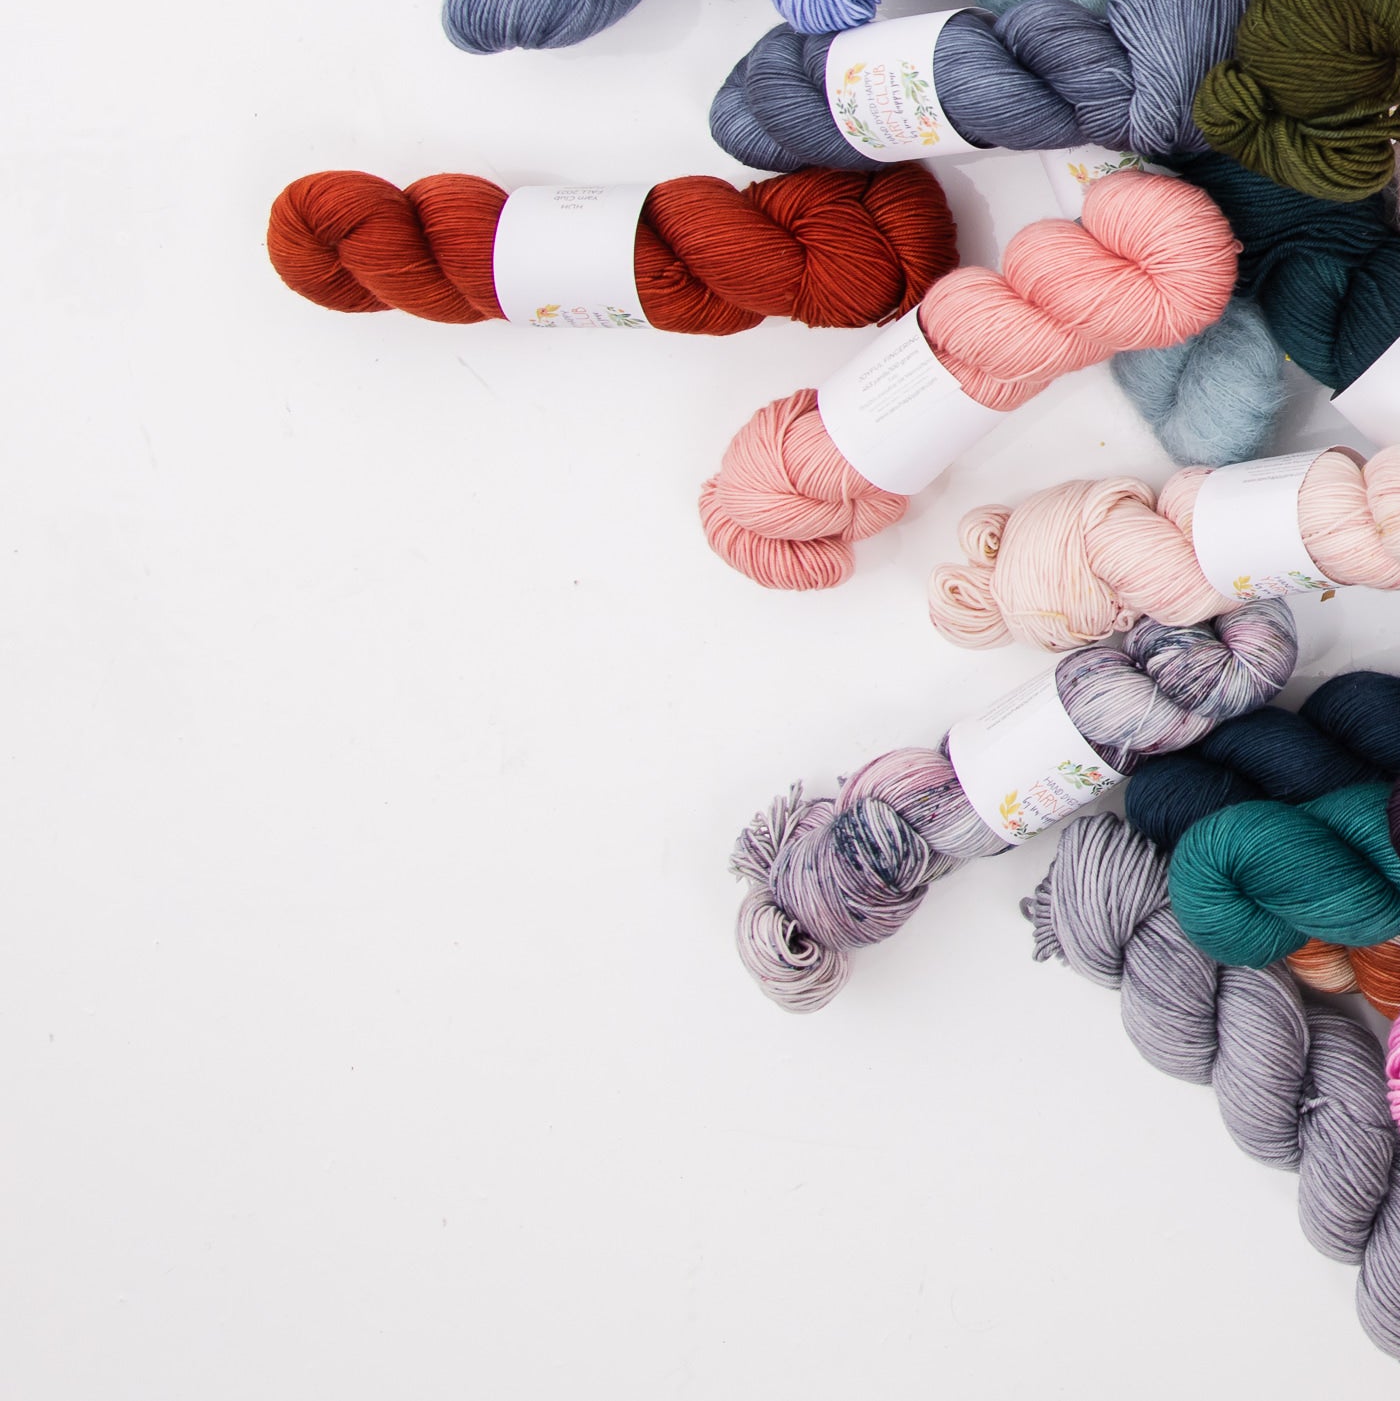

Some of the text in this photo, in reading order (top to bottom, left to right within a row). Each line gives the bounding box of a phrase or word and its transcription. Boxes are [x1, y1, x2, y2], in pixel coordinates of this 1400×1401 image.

[864, 71, 897, 145] HAND DYED HAPPY
[872, 64, 912, 145] YARN CLUB
[892, 90, 904, 114] happy
[1028, 780, 1061, 814] YARN
[1043, 776, 1064, 796] HAND
